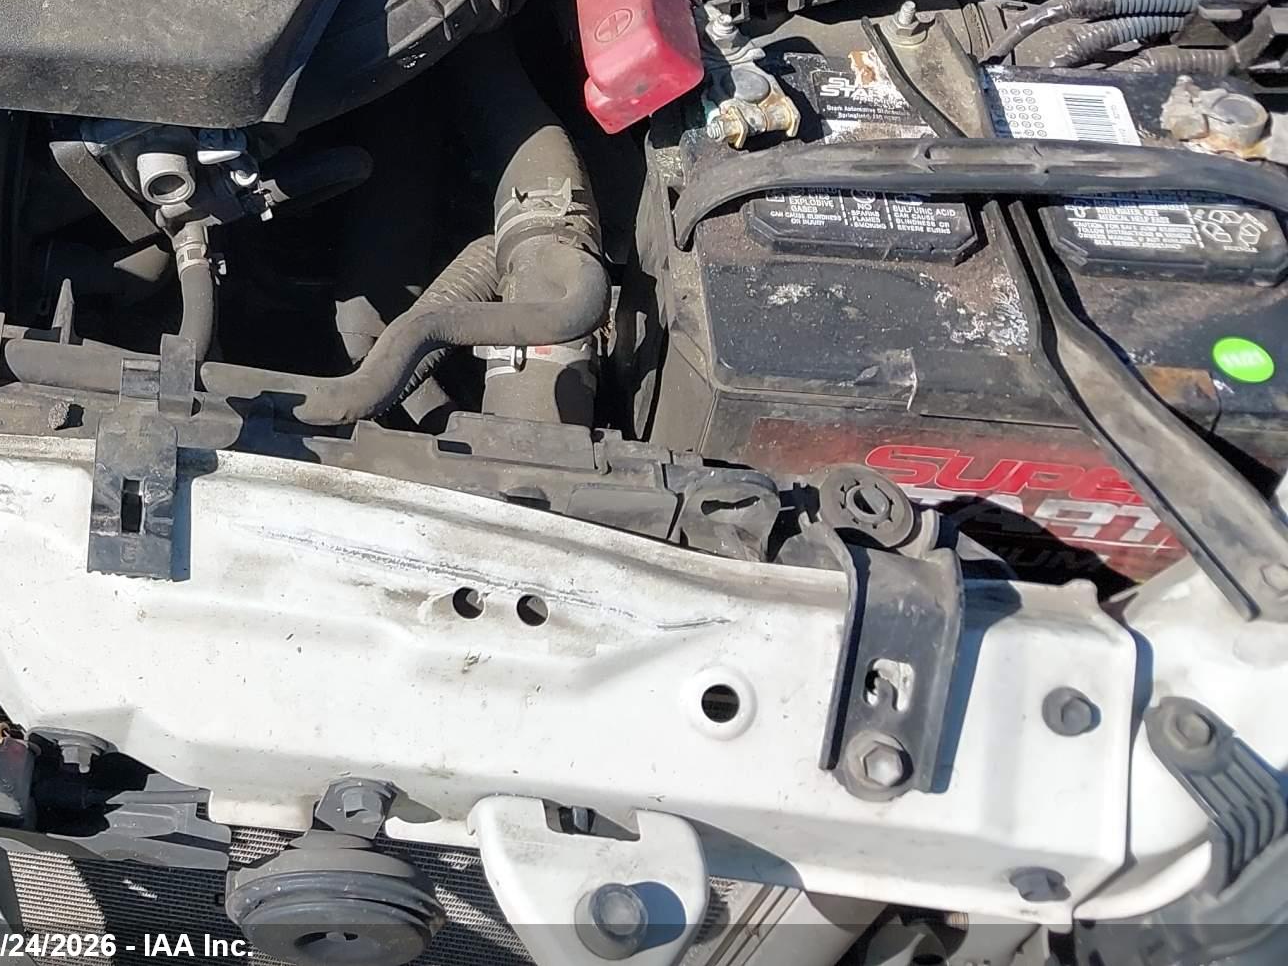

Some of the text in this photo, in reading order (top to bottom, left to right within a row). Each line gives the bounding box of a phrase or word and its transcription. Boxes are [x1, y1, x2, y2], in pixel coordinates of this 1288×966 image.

[857, 203, 872, 211] NO
[935, 208, 956, 217] ACID
[865, 444, 1146, 505] SUPE
